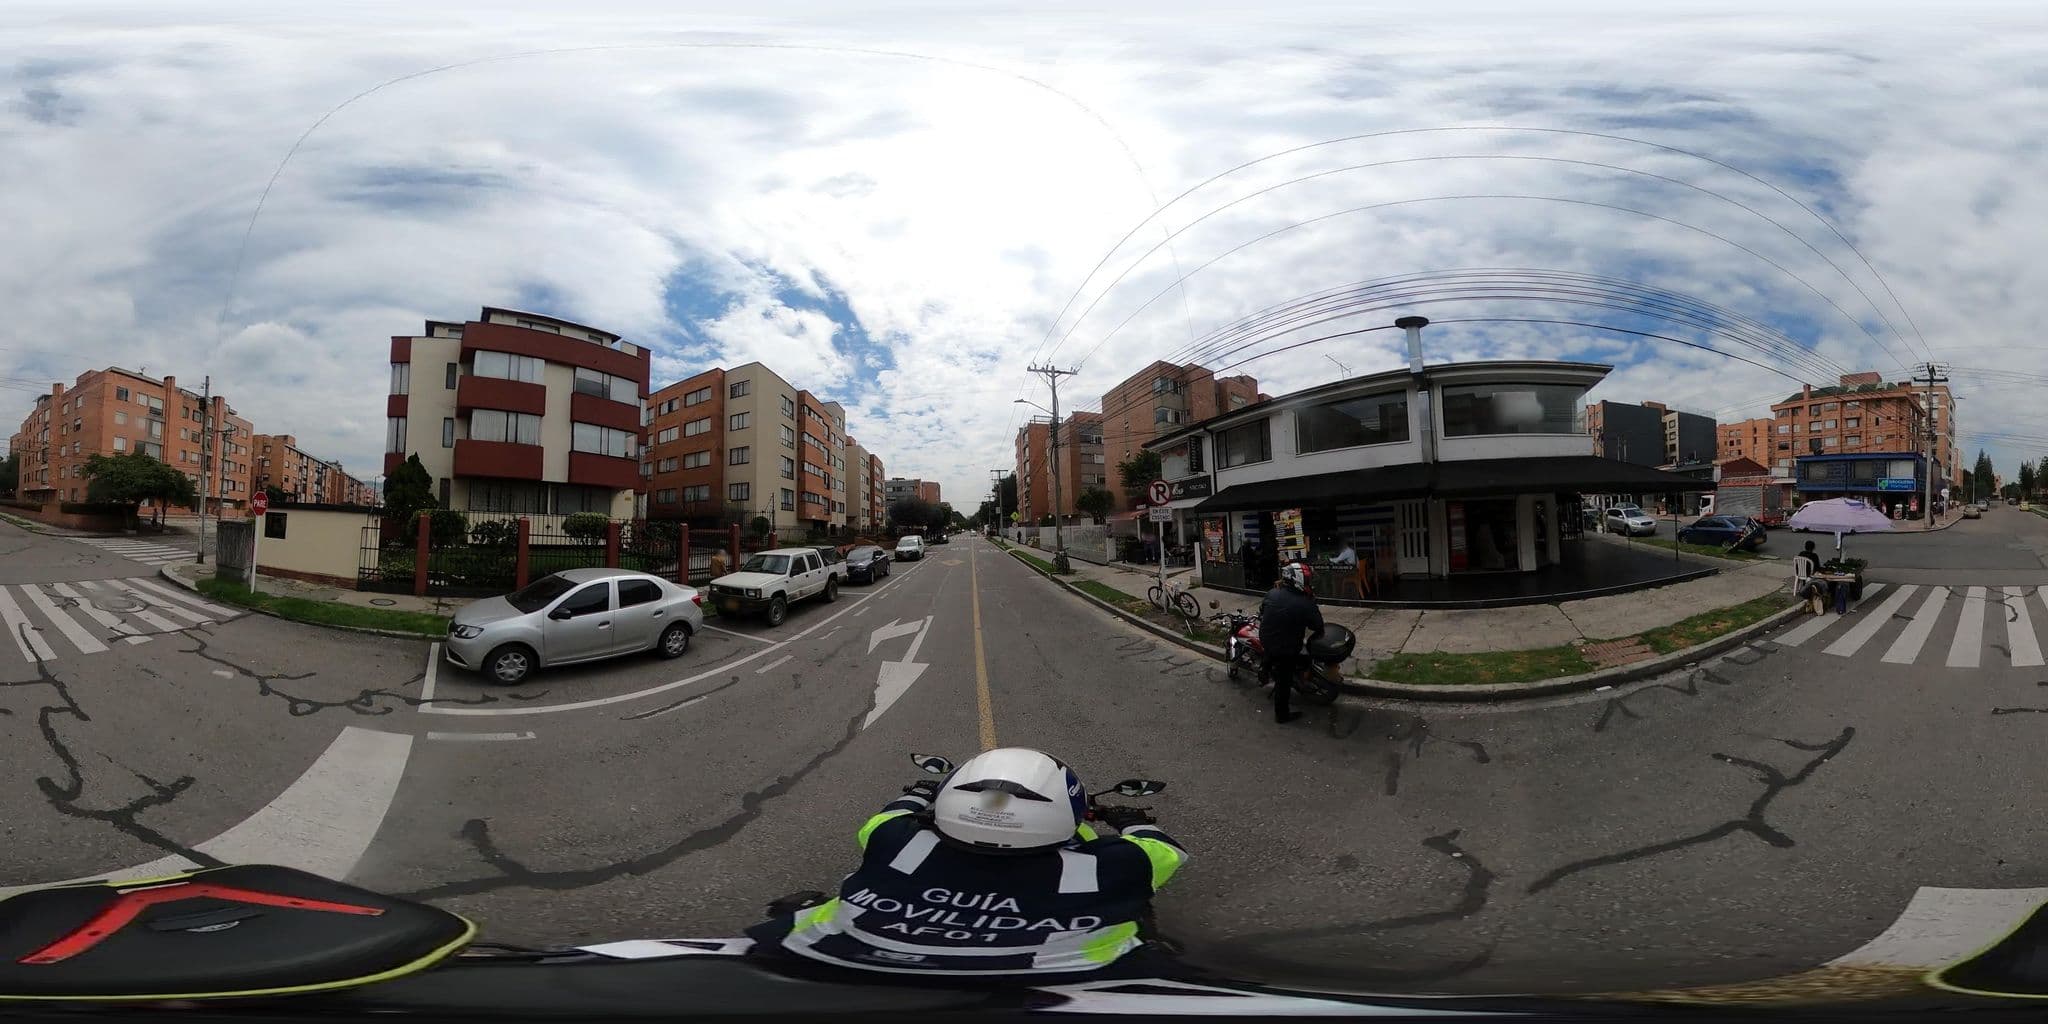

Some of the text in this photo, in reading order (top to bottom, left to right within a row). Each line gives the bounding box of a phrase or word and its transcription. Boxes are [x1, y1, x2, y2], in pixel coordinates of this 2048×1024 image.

[253, 499, 266, 508] PARE
[847, 888, 1102, 932] MOVILIDAD
[921, 887, 1021, 913] GUÍA
[881, 922, 999, 943] AF01
